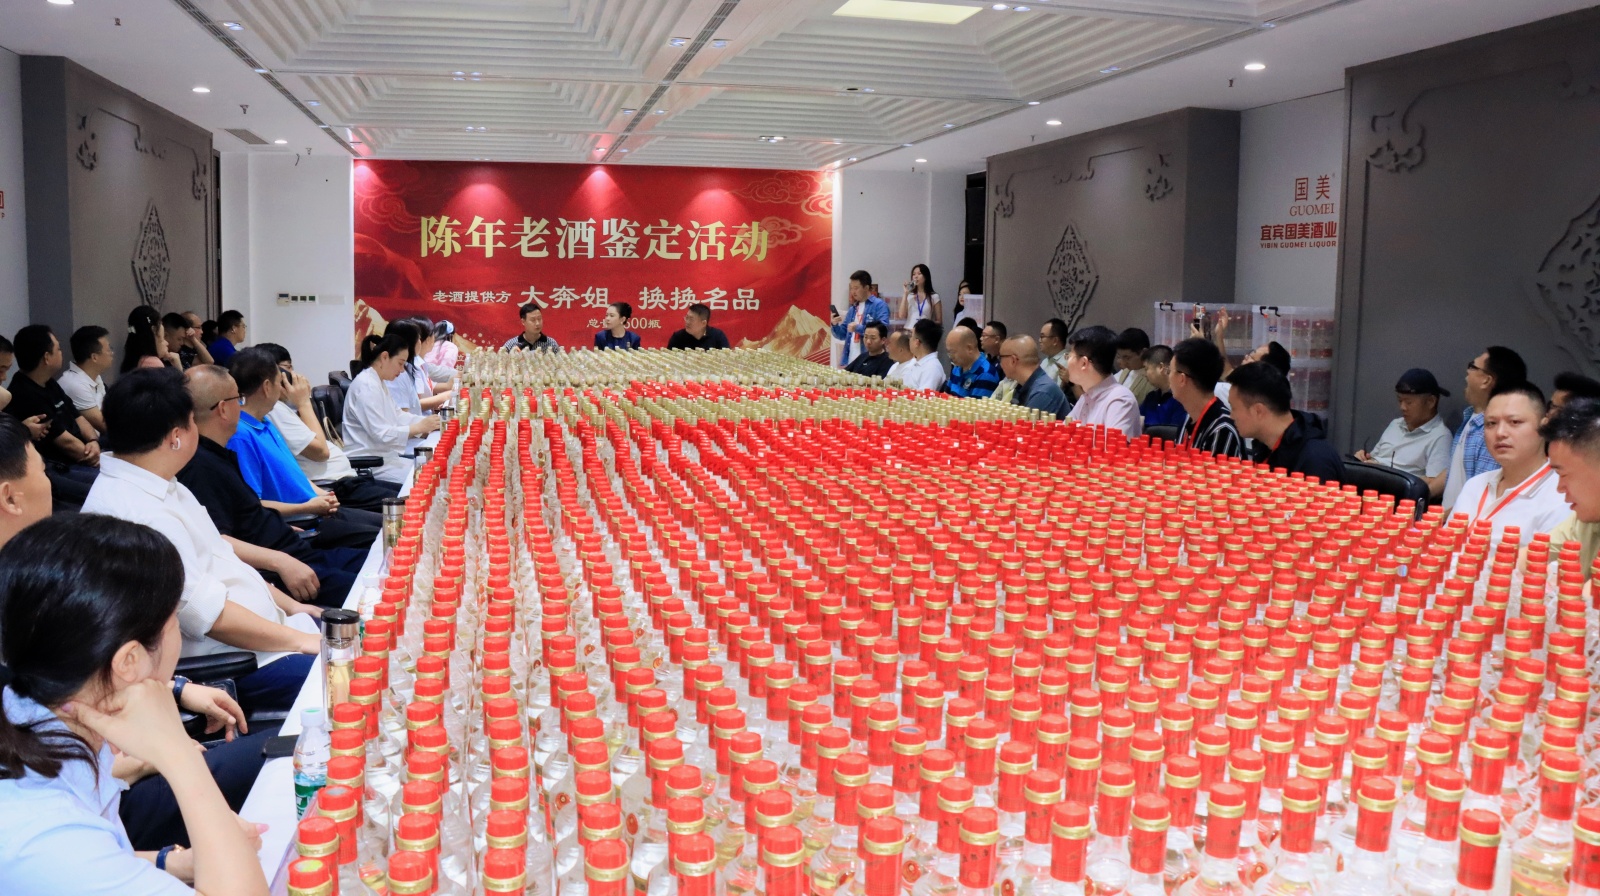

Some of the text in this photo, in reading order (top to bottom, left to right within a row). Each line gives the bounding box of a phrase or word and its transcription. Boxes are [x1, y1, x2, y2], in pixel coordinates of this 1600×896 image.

[1294, 174, 1330, 202] 国美
[1289, 203, 1335, 216] GUOMEI
[420, 215, 770, 262] 陈年老酒鉴定活动
[1260, 221, 1337, 241] 宜宾国美酒业
[1280, 241, 1307, 249] GUOMEI
[1309, 240, 1337, 248] LIQUOR
[432, 285, 760, 311] 老酒提供方 大奔姐 换换名品
